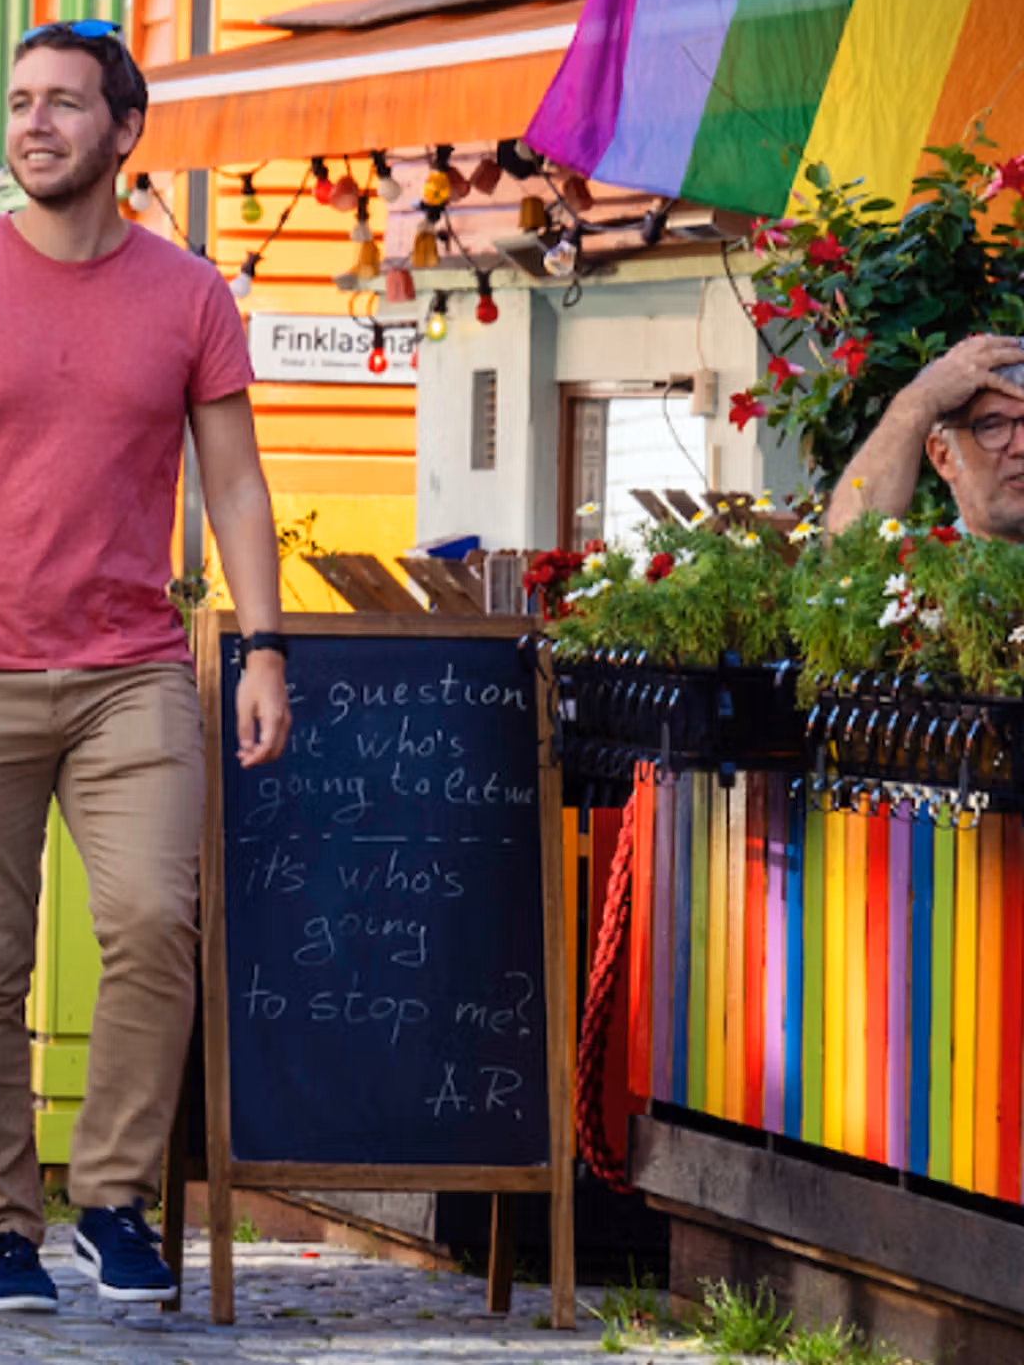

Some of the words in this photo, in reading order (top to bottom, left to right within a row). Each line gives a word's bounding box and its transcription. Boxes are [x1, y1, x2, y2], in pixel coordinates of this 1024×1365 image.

[328, 663, 528, 724] question
[357, 716, 465, 759] who's
[247, 776, 373, 824] going
[391, 762, 431, 796] to
[244, 846, 305, 894] it's
[338, 849, 465, 898] who's
[293, 914, 428, 966] going
[240, 964, 287, 1020] to
[310, 971, 430, 1044] stop
[455, 971, 534, 1037] me?
